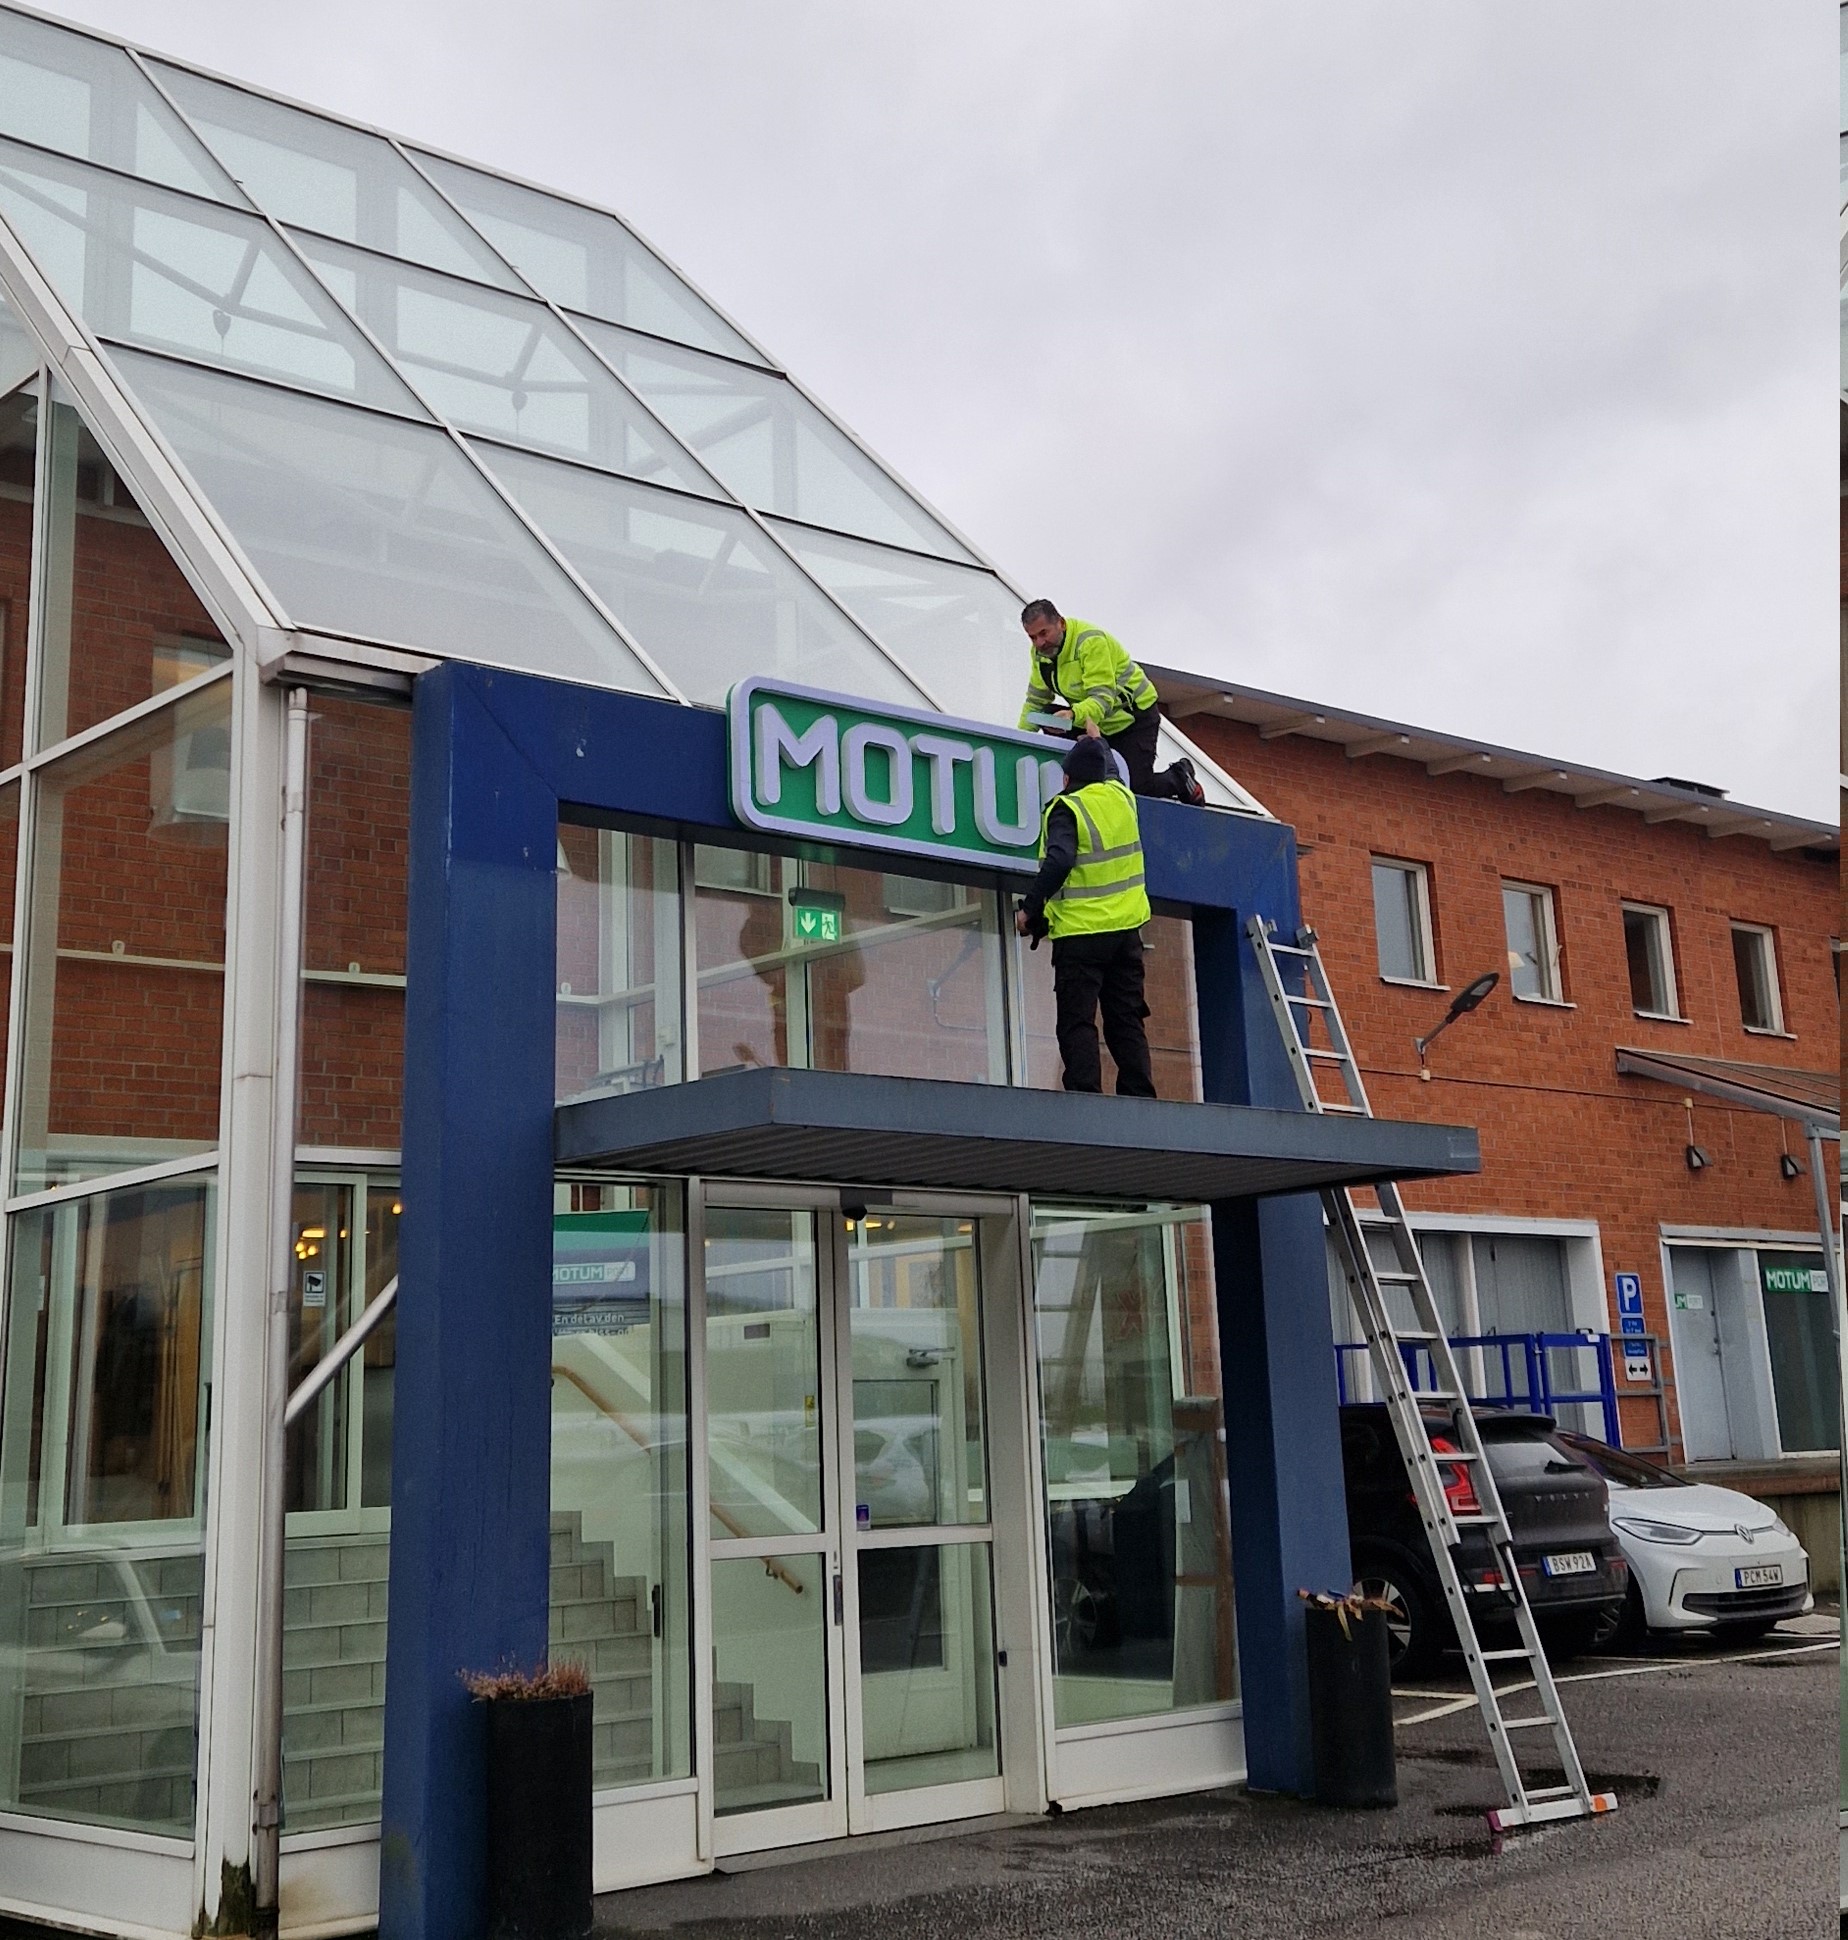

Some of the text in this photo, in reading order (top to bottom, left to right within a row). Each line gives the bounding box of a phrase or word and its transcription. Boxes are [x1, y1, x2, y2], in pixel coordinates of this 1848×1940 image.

[755, 702, 1064, 847] MOTU
[1621, 1277, 1637, 1311] P
[1765, 1270, 1811, 1290] MOTUM
